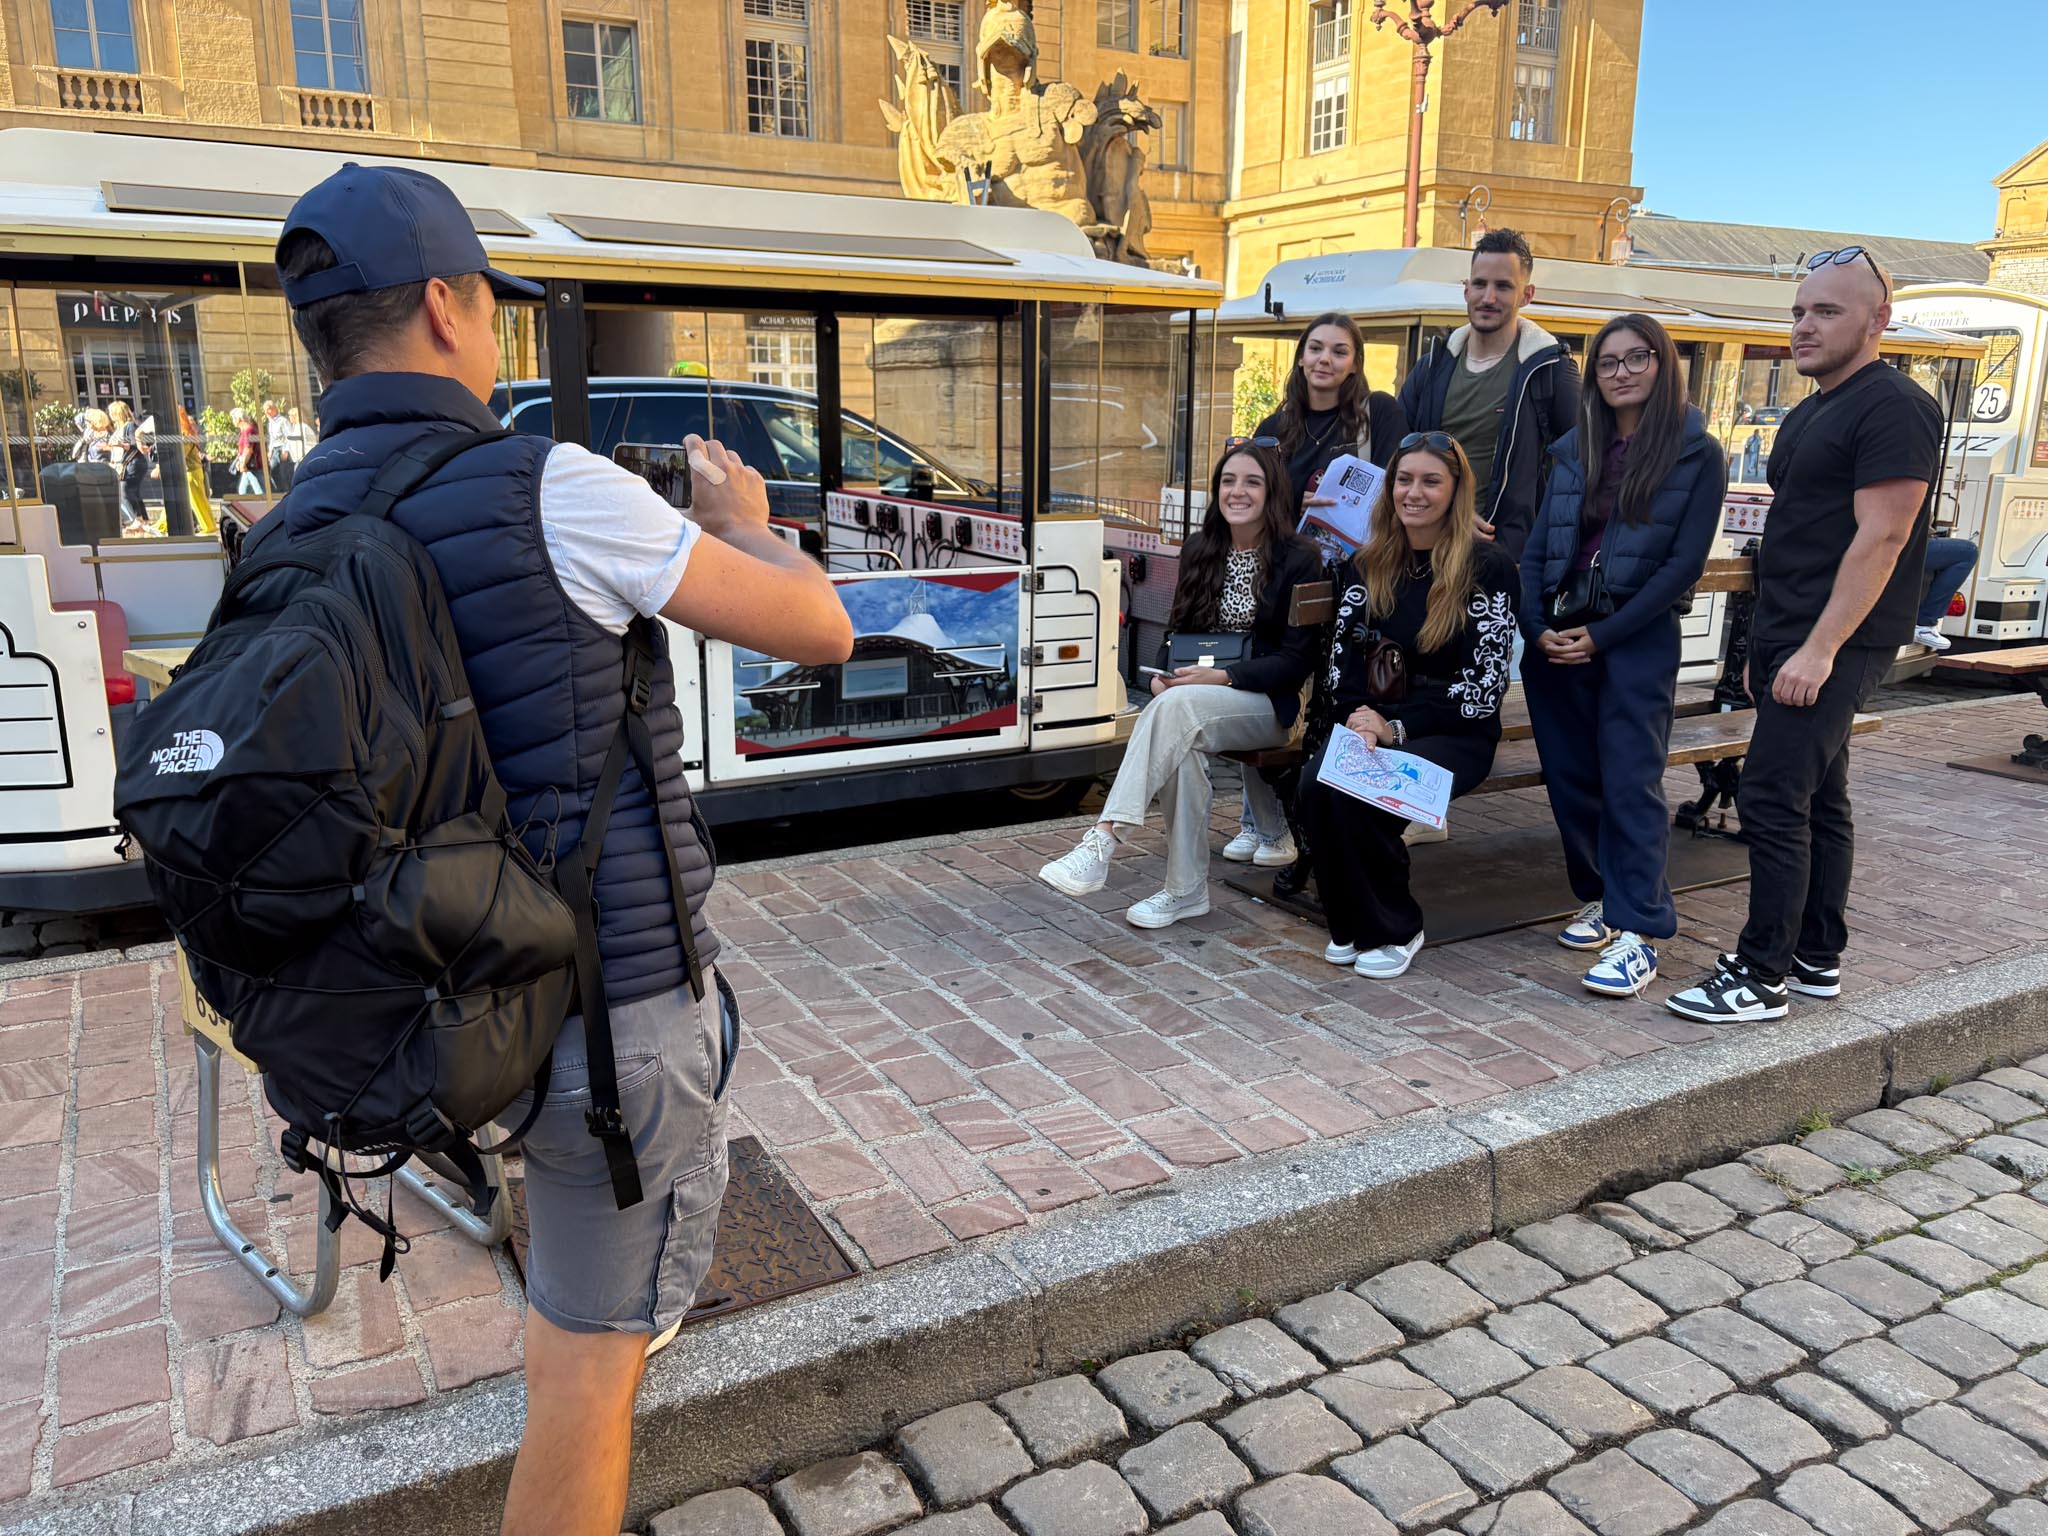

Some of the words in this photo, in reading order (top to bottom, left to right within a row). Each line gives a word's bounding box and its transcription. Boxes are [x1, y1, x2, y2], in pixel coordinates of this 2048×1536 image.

[101, 306, 120, 321] LE
[1976, 387, 2001, 415] 25
[173, 730, 201, 747] THE
[149, 745, 200, 764] NORTH
[155, 759, 194, 776] FACE
